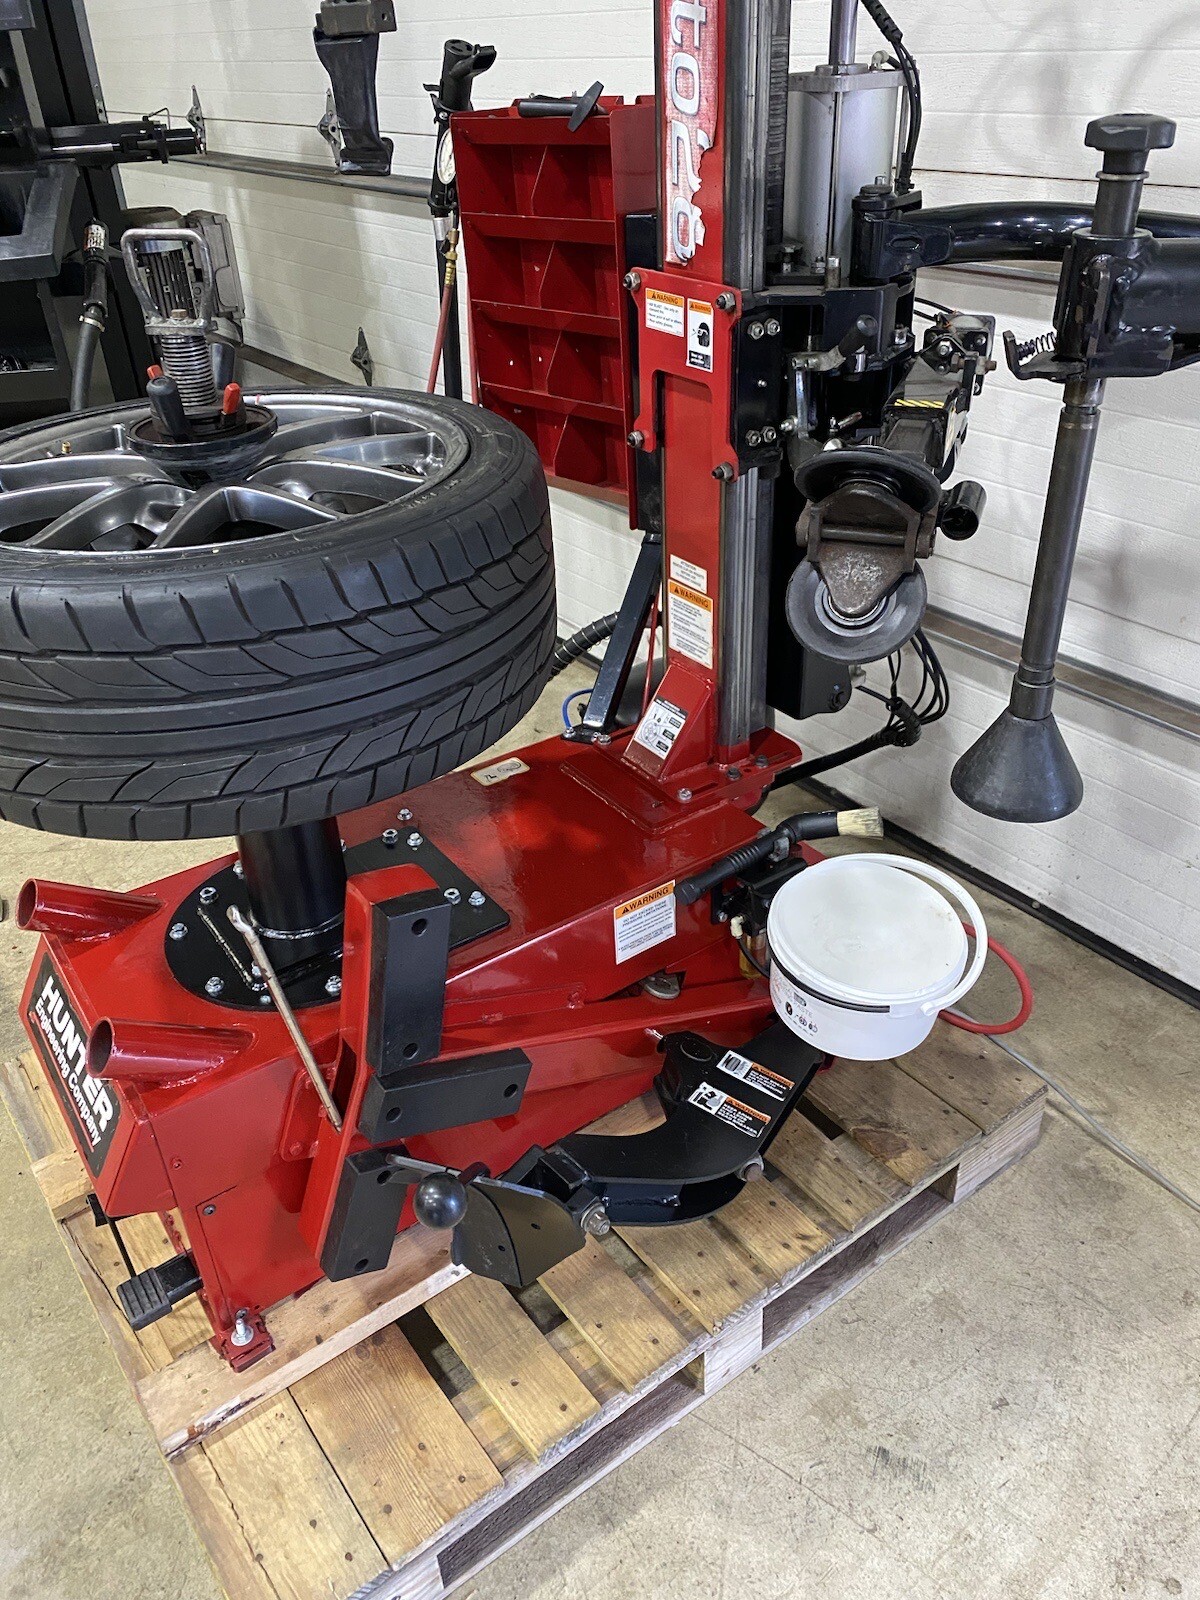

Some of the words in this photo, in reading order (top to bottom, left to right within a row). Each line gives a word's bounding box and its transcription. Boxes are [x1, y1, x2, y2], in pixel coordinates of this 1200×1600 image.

[680, 589, 709, 608] WARNING
[629, 886, 669, 910] WARNING
[41, 975, 114, 1132] HUNTER
[35, 997, 71, 1079] Engineering
[68, 1075, 101, 1147] Company
[760, 1068, 791, 1086] WARNING
[735, 1101, 768, 1122] WARNING
